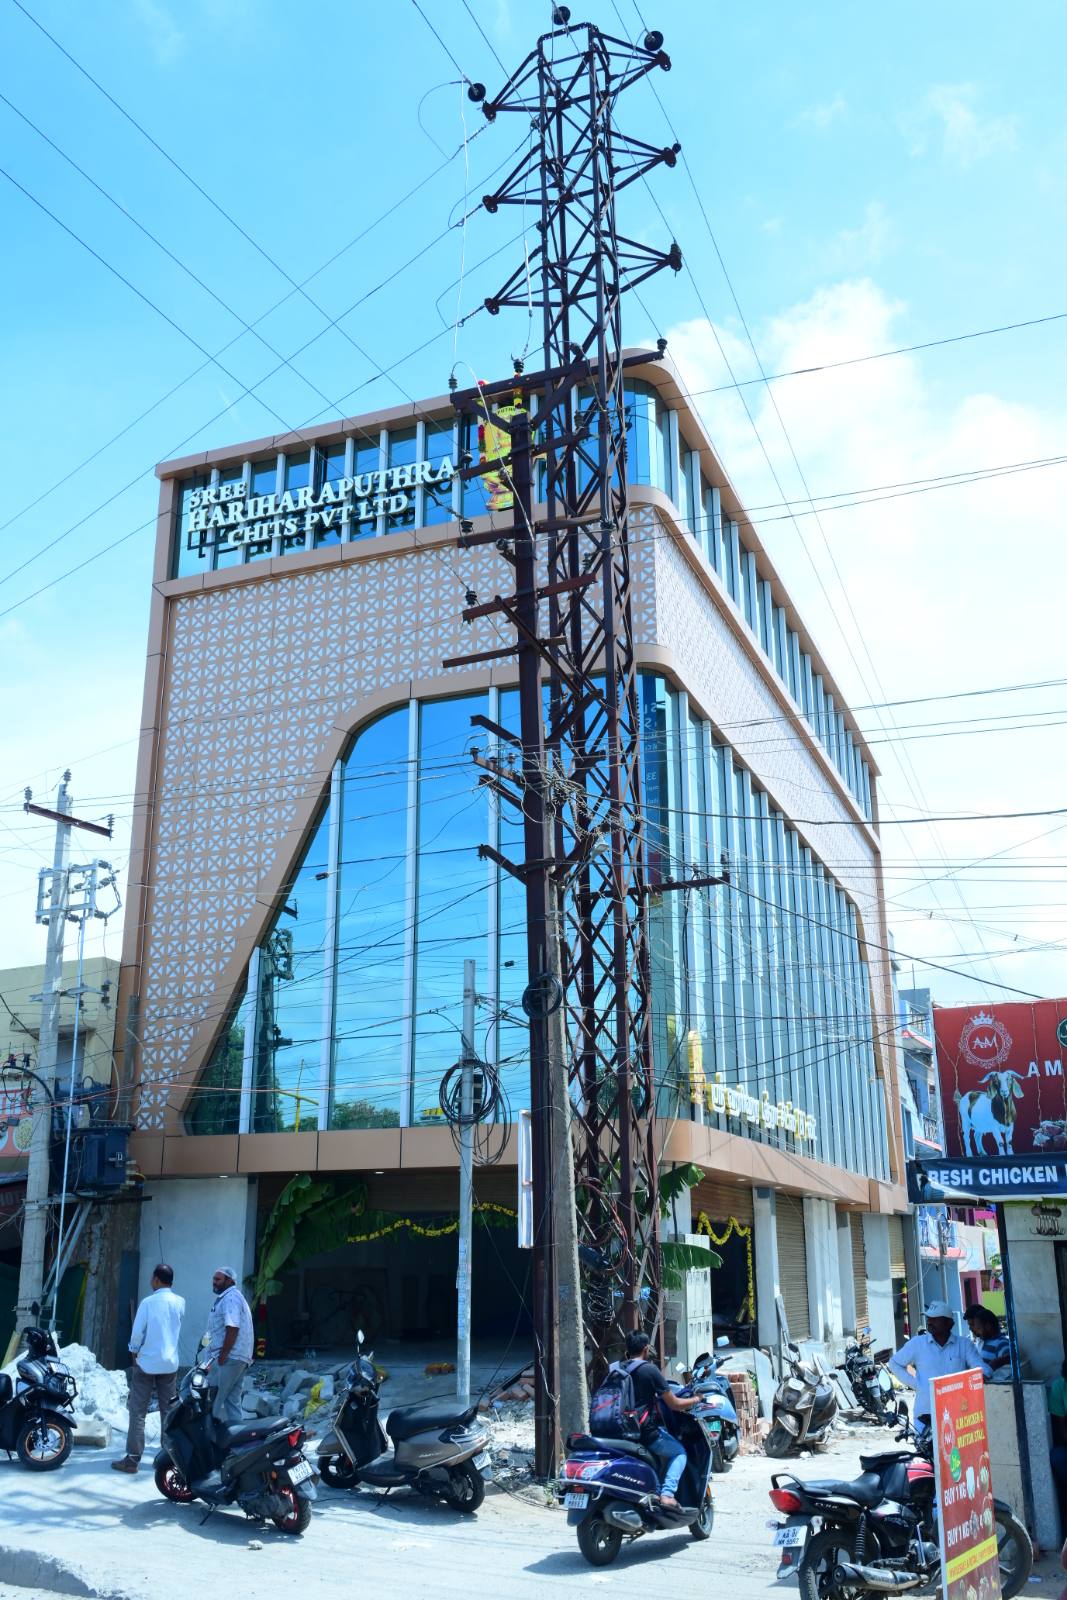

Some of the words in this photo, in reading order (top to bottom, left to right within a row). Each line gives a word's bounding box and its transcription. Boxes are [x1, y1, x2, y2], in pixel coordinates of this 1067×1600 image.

[187, 456, 456, 533] HARIHARAPUTHRA
[189, 480, 248, 509] SREE
[227, 519, 299, 547] CHITS
[304, 505, 353, 531] PVT
[358, 494, 409, 520] LTD
[979, 1165, 1058, 1186] CHICKEN
[944, 1487, 955, 1506] BUY
[947, 1527, 958, 1547] BUY
